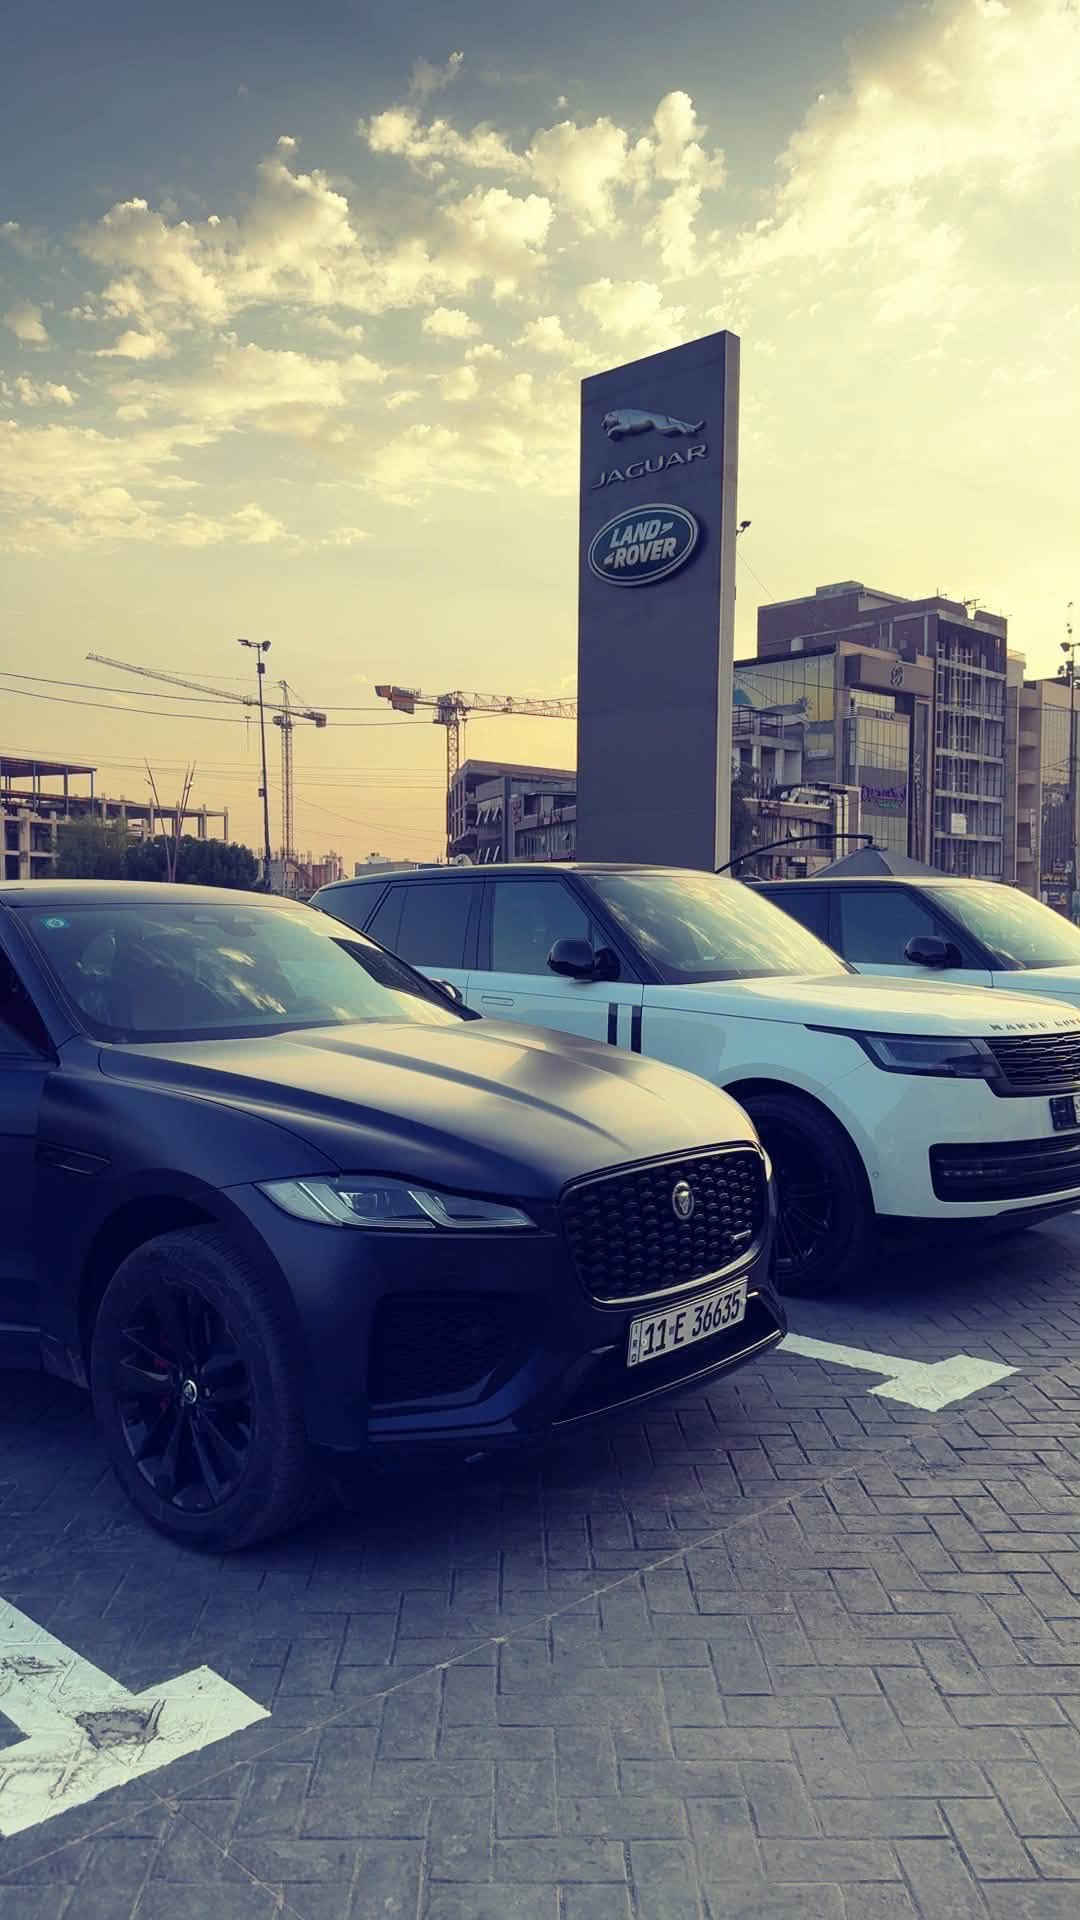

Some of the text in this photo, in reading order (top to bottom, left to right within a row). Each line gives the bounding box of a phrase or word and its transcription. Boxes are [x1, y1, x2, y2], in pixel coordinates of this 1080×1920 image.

[591, 444, 708, 489] JAGUAR
[609, 519, 662, 549] LAND
[613, 537, 677, 569] ROVER
[692, 1289, 741, 1337] 36635
